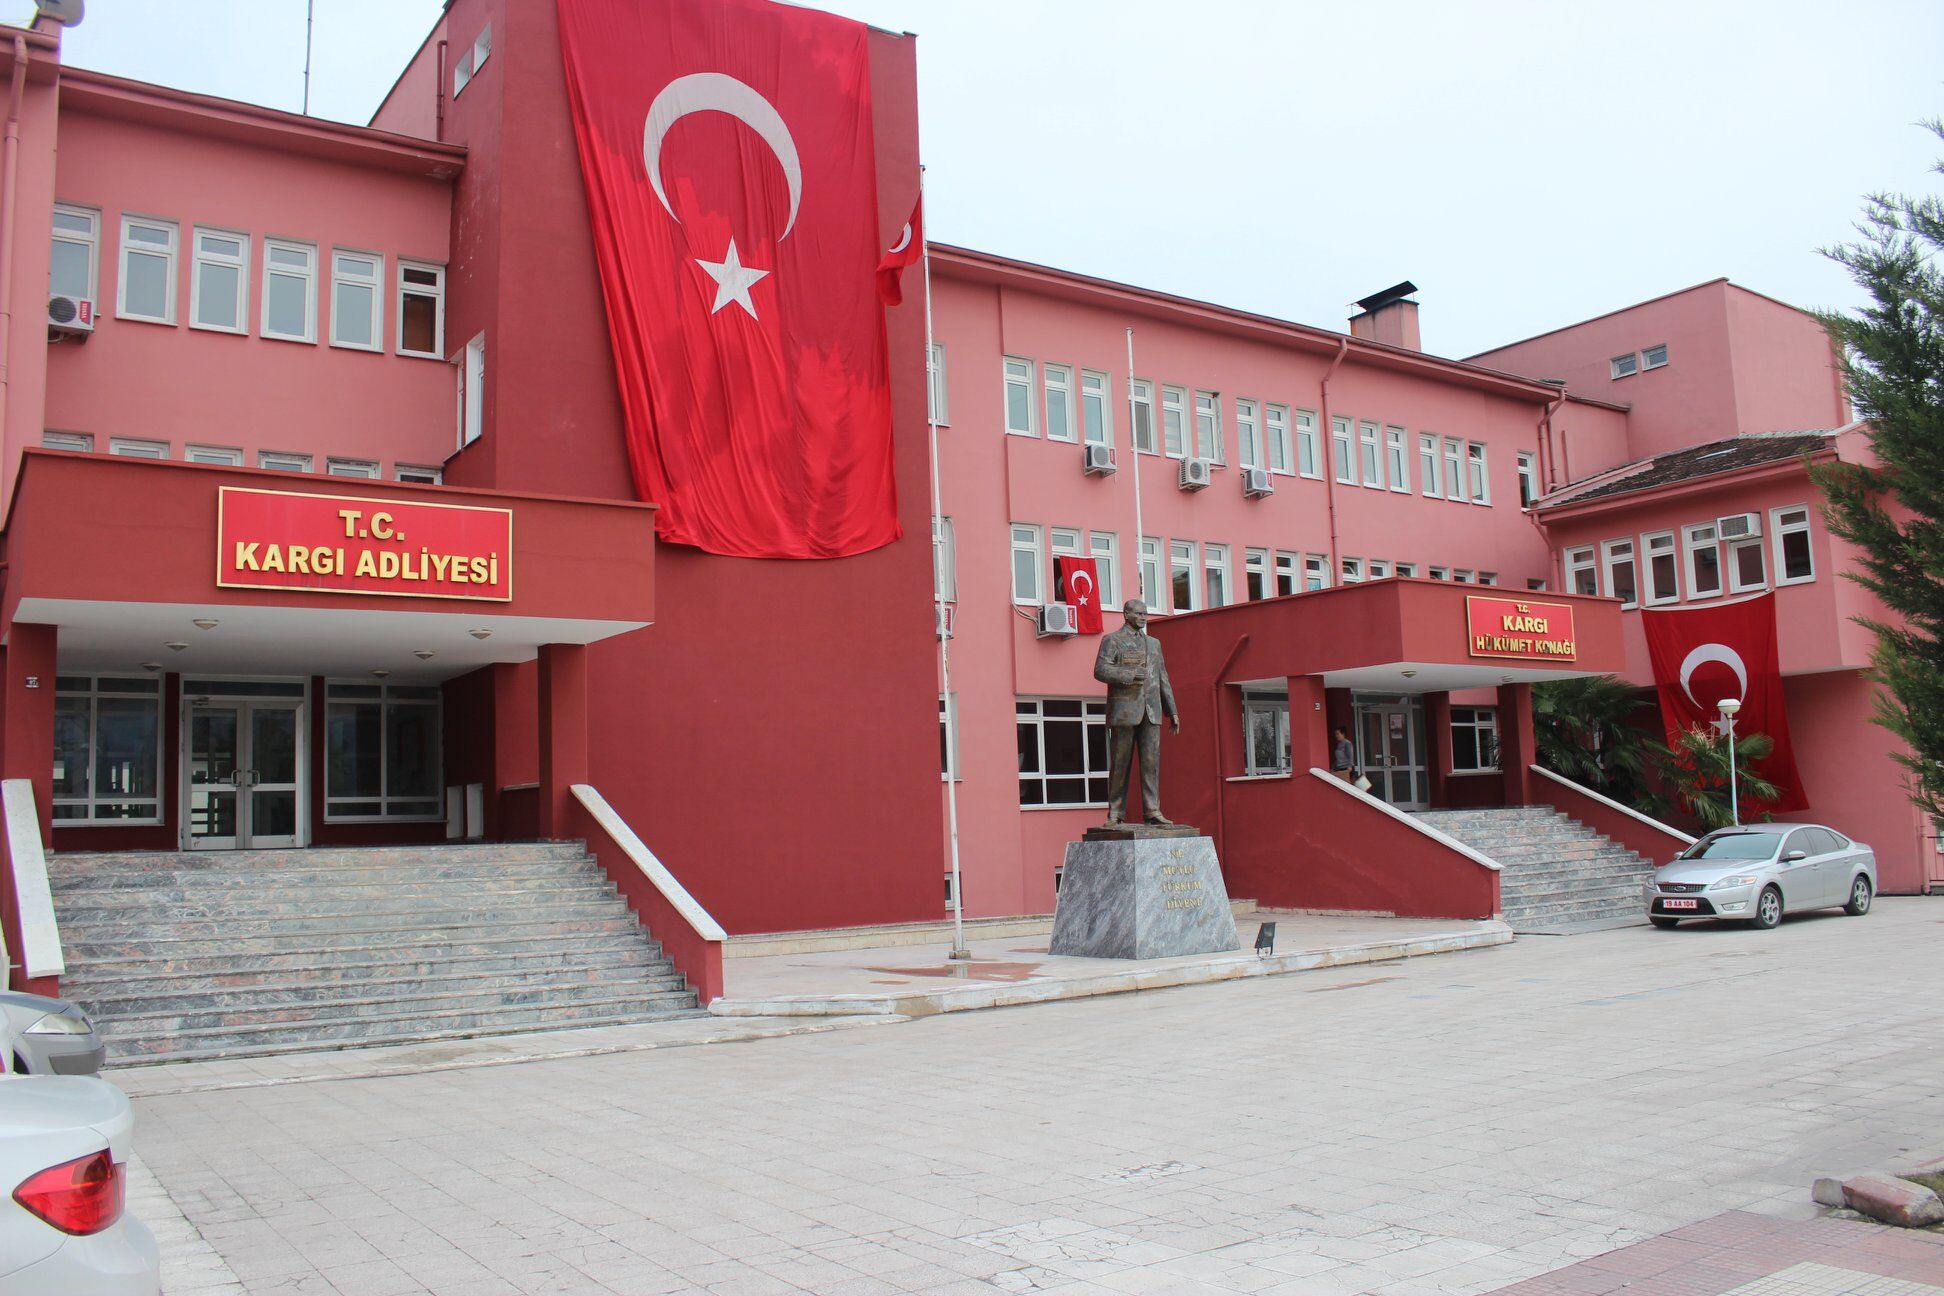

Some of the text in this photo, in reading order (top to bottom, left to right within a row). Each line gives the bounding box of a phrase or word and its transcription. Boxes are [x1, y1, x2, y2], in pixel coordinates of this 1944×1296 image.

[339, 509, 405, 541] T.C.
[235, 541, 498, 585] KARGI ADLİYESİ
[1516, 604, 1530, 613] T.C.
[1502, 615, 1548, 633] KARGI
[1476, 633, 1575, 655] HÜKÜMET KONAĞI
